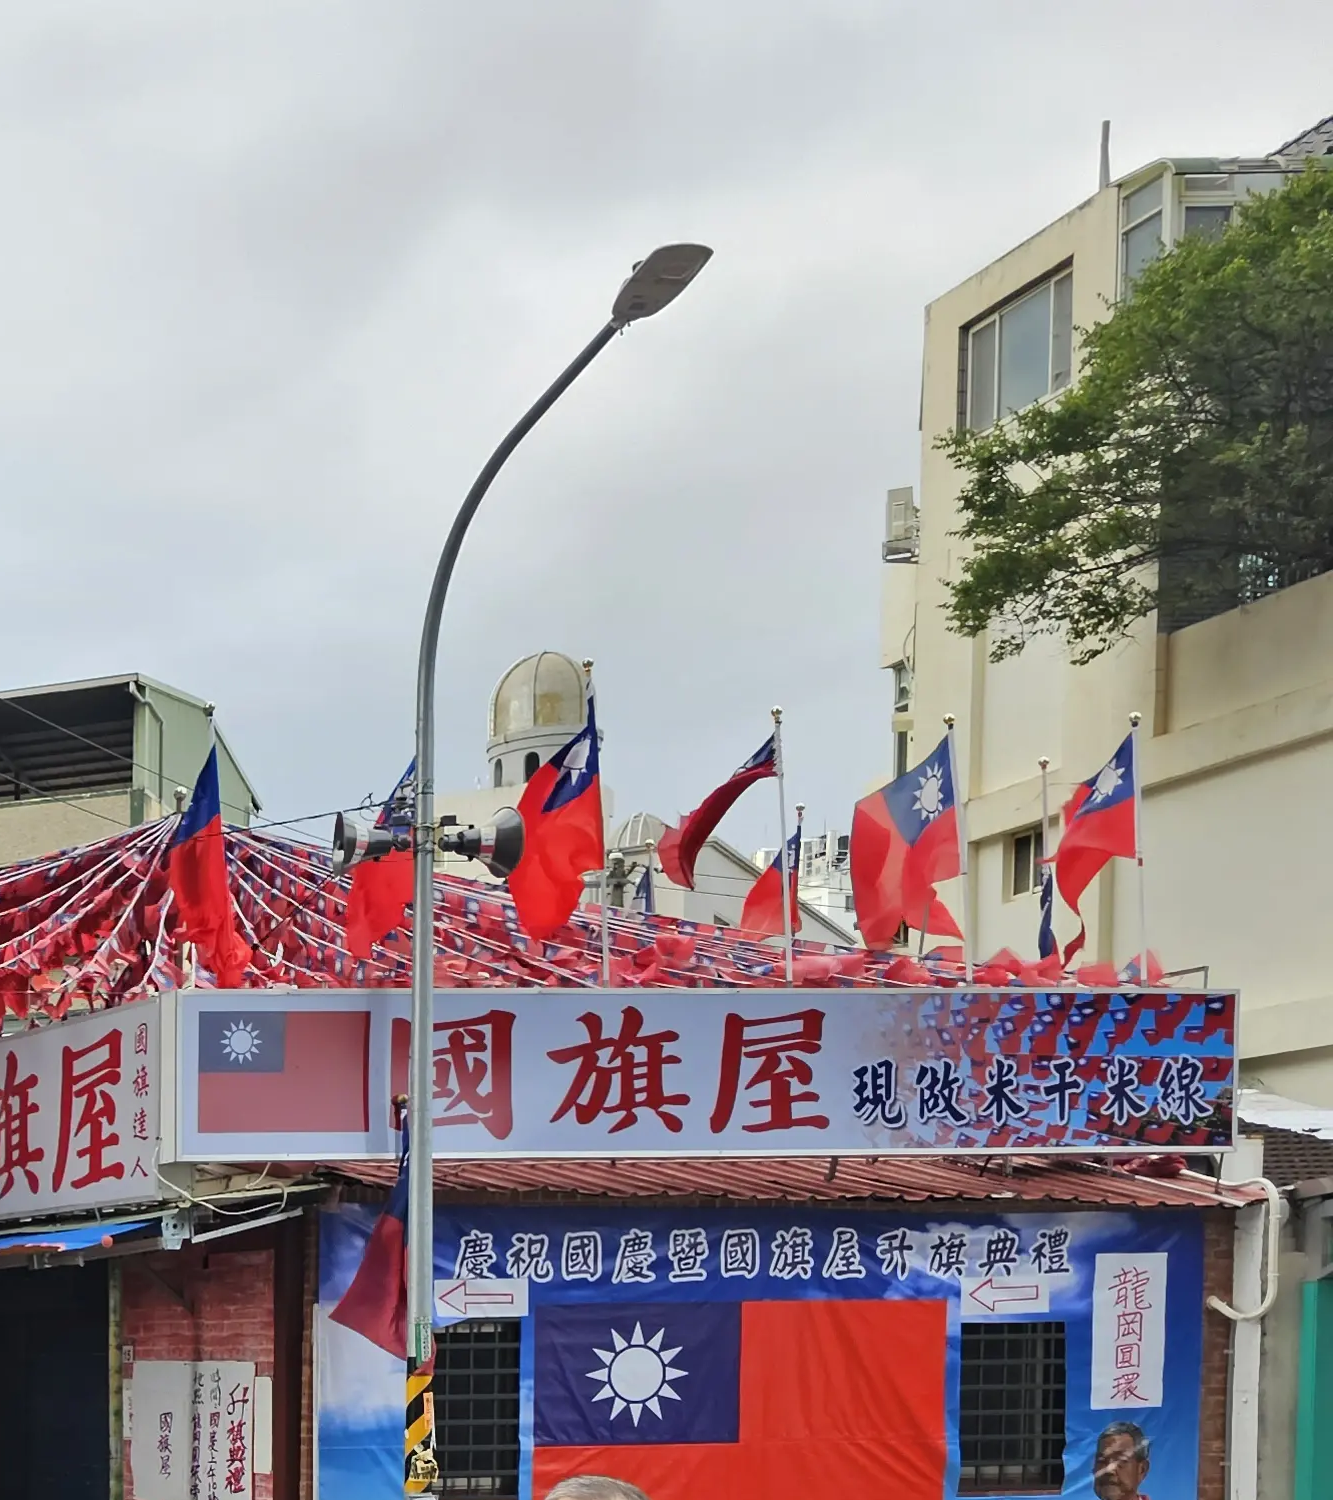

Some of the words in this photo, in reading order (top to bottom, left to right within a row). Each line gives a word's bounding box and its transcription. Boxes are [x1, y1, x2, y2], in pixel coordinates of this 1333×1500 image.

[130, 1022, 149, 1178] 國旗達人
[390, 1006, 830, 1140] 國旗屋
[853, 1054, 1213, 1130] 現做米干米線
[455, 1227, 1073, 1281] 慶祝國慶暨國旗屋升旗典禮
[1108, 1267, 1152, 1402] 龍岡圓環
